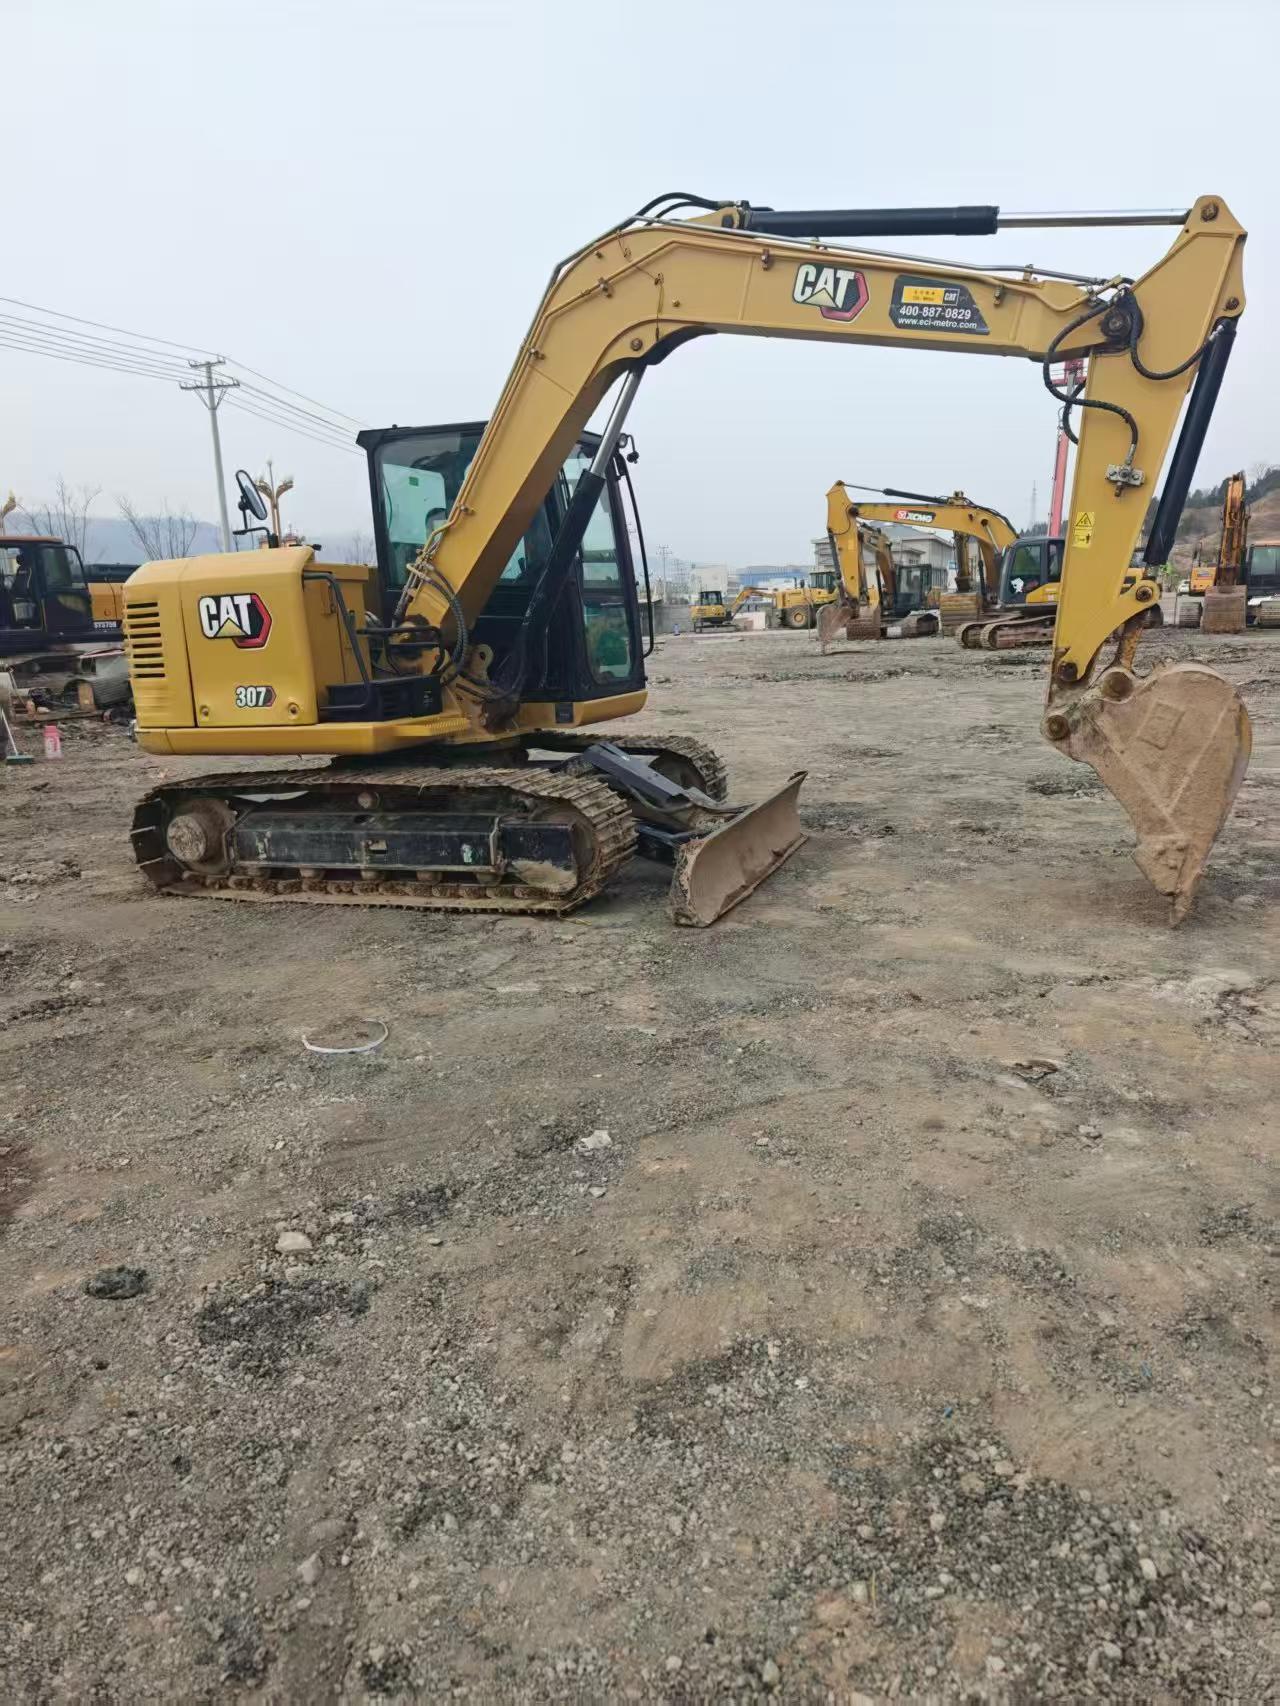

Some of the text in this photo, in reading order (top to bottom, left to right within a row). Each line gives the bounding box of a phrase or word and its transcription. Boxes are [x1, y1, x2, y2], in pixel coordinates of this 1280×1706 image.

[793, 264, 855, 309] CAT
[944, 292, 957, 301] CAT
[899, 305, 971, 320] 400-887-0829
[898, 317, 977, 329] www.eci-metro.com
[199, 594, 252, 638] CAT
[236, 686, 267, 707] 307
